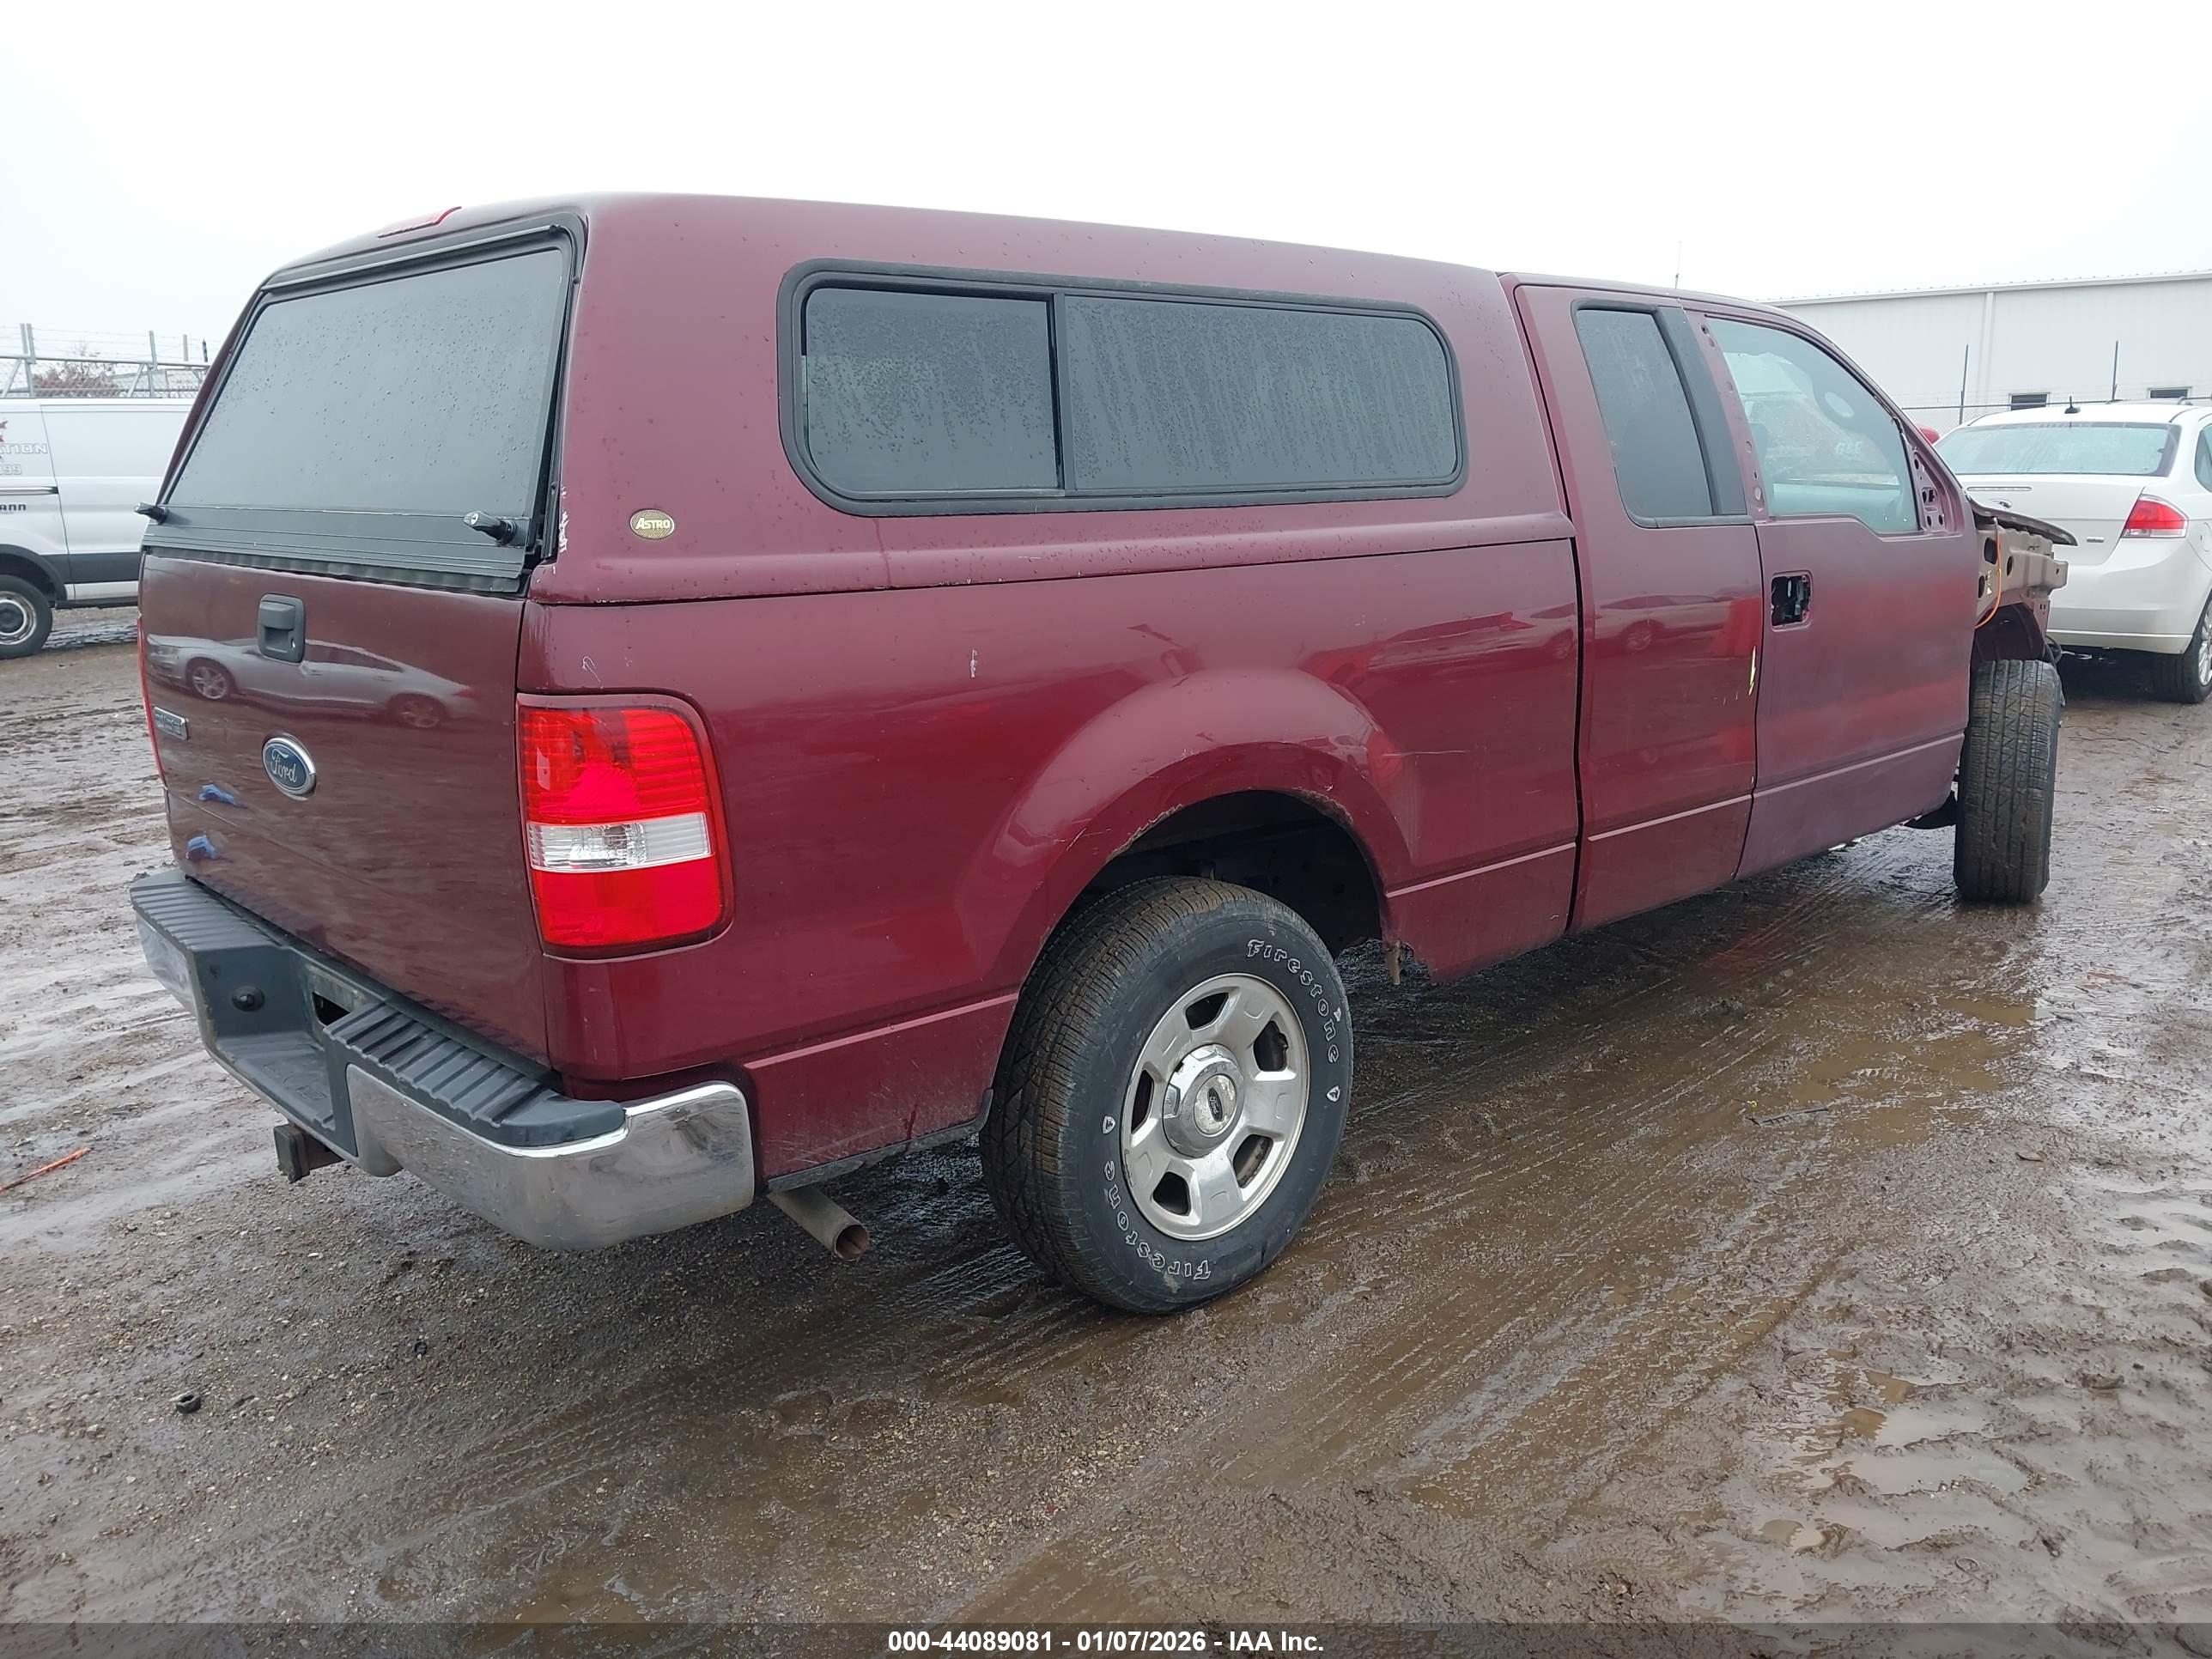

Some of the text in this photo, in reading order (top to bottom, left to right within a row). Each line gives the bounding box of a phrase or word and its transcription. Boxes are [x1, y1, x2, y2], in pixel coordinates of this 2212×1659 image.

[270, 748, 297, 783] Ford
[1247, 939, 1340, 1064] Firestone
[1104, 1160, 1212, 1281] Firestone
